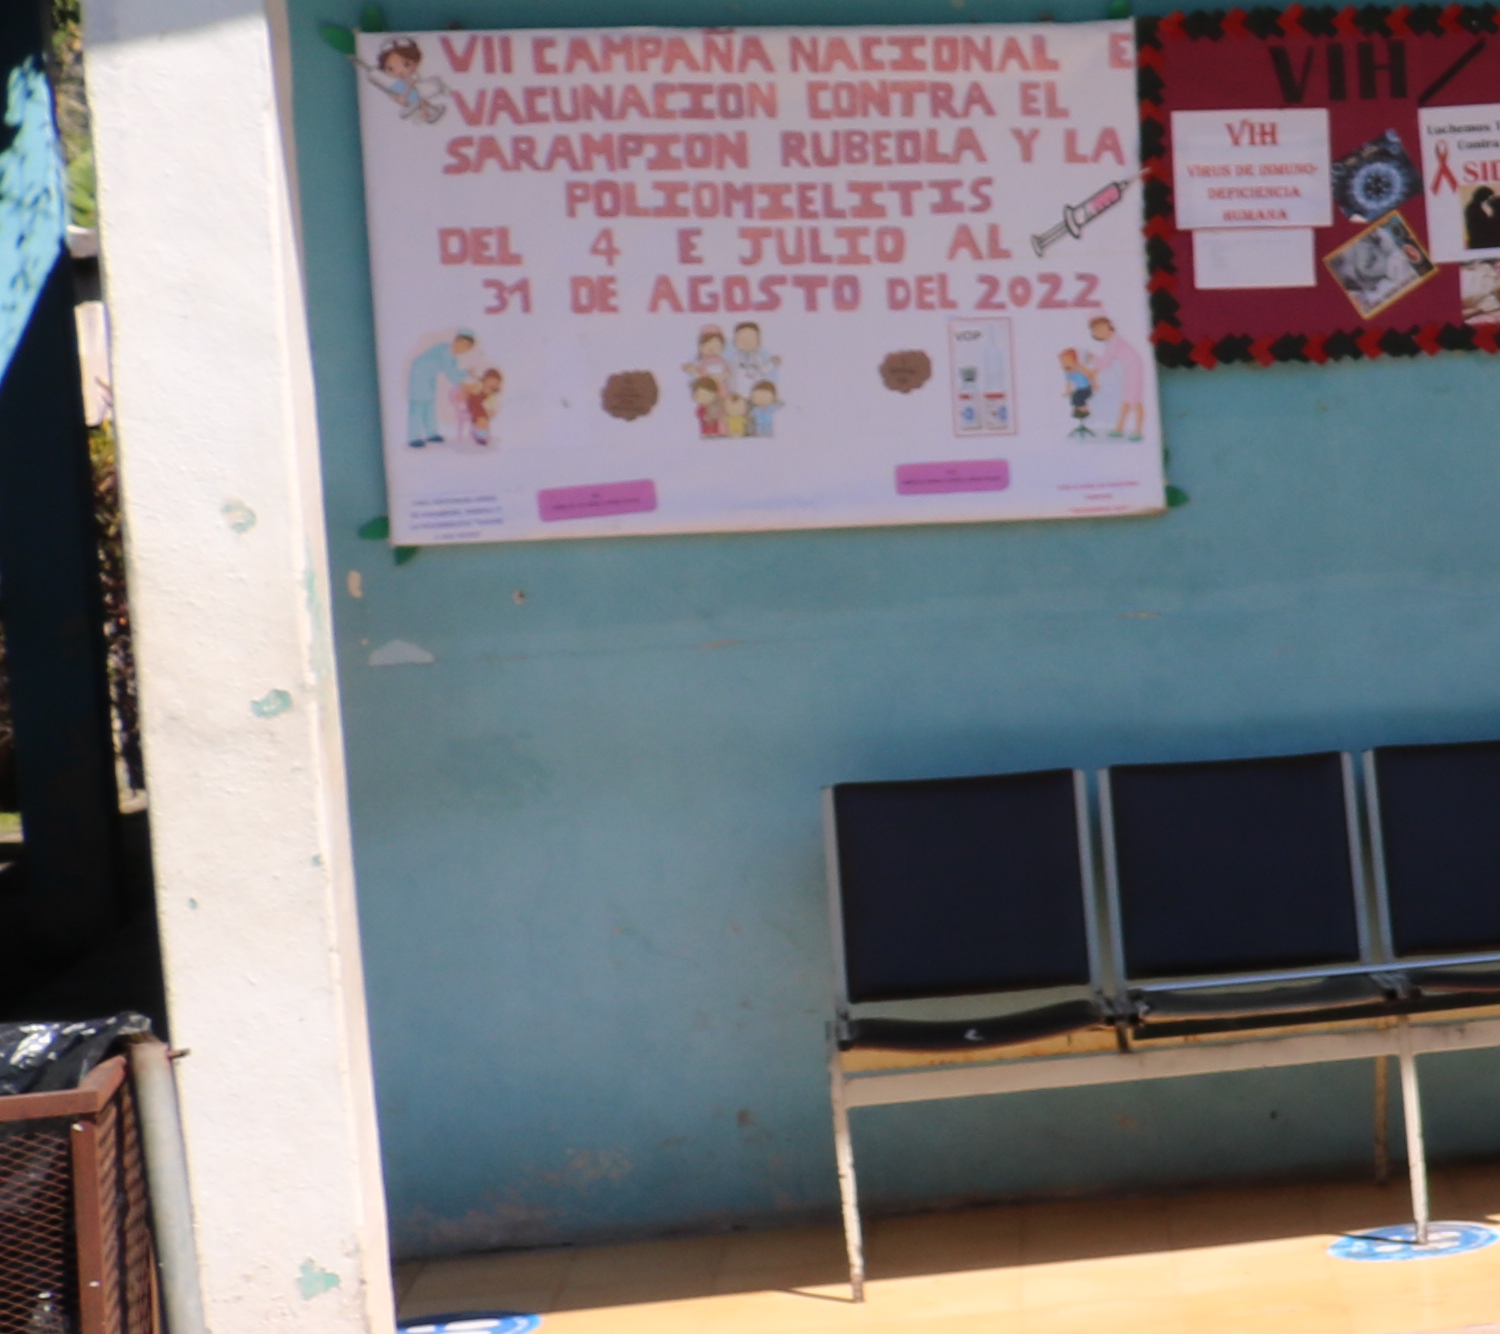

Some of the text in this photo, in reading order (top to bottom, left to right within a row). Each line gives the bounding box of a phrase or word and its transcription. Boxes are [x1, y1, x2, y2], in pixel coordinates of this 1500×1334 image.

[440, 35, 513, 74] VII
[532, 26, 775, 74] CAMPAÑA
[789, 34, 1060, 73] NACIONAL
[1268, 40, 1408, 104] VIH
[451, 80, 1070, 127] VACUNACION CONTRA EL
[443, 127, 1126, 175] SARAMPION RUBEOLA Y LA
[1225, 119, 1278, 146] VIH
[565, 177, 993, 220] POLIOMIELITIS
[438, 223, 1012, 267] DEL 4 E JULIO AL
[482, 272, 1102, 315] 31 DE AGOSTO DEL 2022
